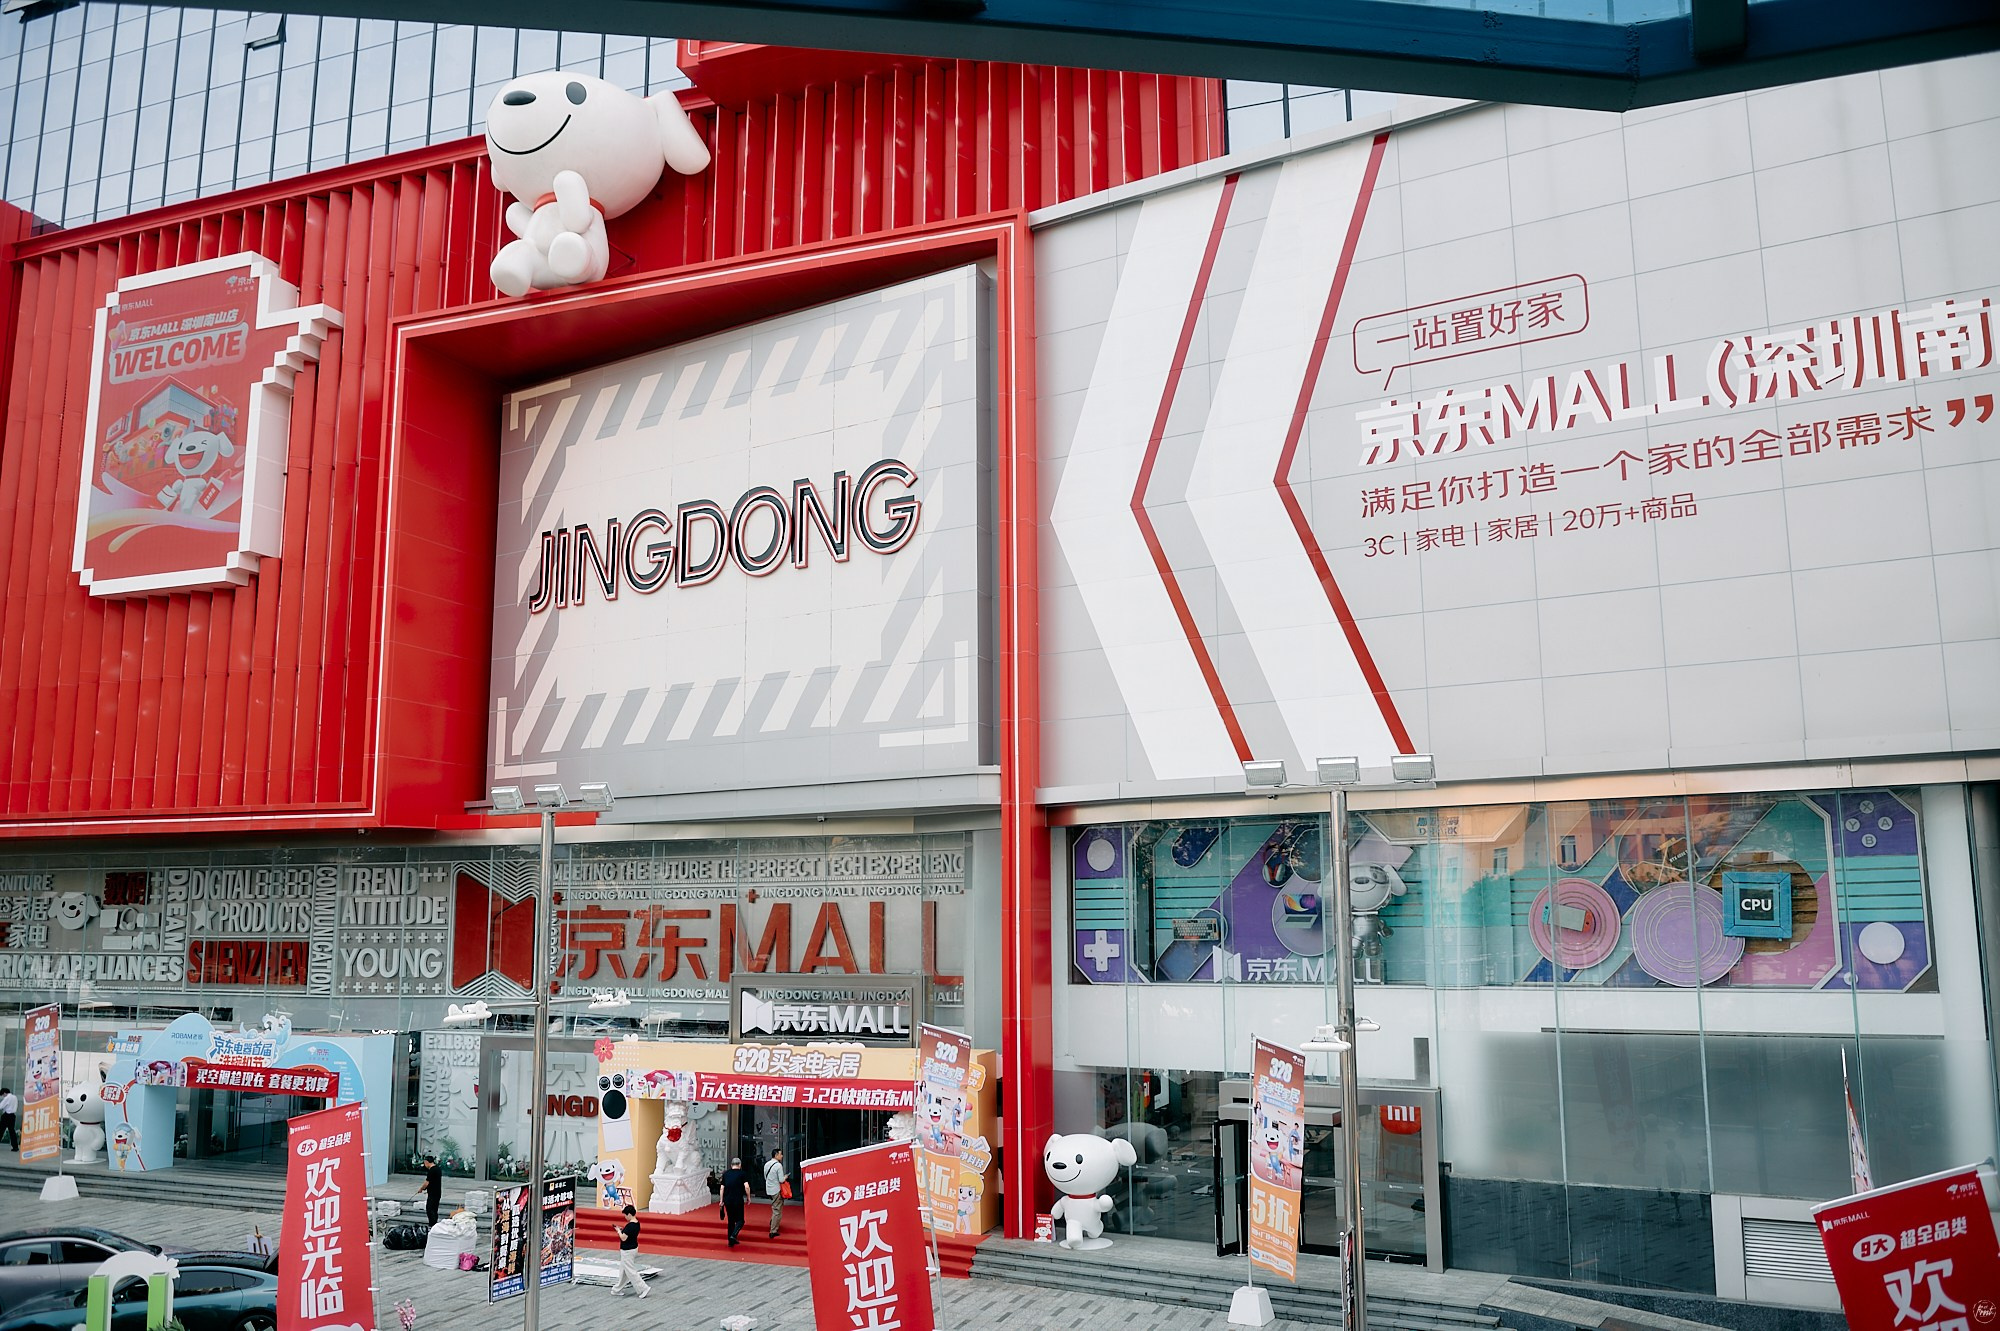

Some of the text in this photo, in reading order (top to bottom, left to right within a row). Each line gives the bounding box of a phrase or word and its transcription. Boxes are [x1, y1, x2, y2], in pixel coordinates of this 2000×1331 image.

[129, 309, 240, 341] 京东MALL 深圳南山店
[1376, 292, 1565, 352] 一站置好家
[114, 330, 243, 377] WELCOME
[1355, 298, 2000, 467] 京东MALL(深圳南
[529, 458, 921, 614] JINGDONG
[1364, 492, 1698, 558] 3C 家电 家居 20万+商品
[552, 862, 617, 881] MEETING
[619, 861, 649, 880] THE
[651, 860, 712, 880] FUTURE
[713, 858, 748, 879] THE
[749, 857, 821, 878] PERFECT
[191, 869, 255, 900] DIGITAL
[562, 890, 618, 900] JINGDONG
[759, 886, 822, 898] JINGDONG
[859, 885, 922, 897] JINGDONG
[11, 896, 49, 921] 家居
[164, 870, 189, 951] DREAM
[218, 902, 312, 933] PRODUCTS
[341, 896, 448, 925] ATTITUDE
[1740, 899, 1772, 911] CPU
[9, 923, 48, 949] 家电
[309, 866, 337, 995] COMMUNICATION
[556, 900, 964, 986] 京东MALL
[55, 955, 184, 982] APPLIANCES
[186, 940, 310, 986] SHENZHEN
[340, 947, 444, 978] YOUNG
[1247, 958, 1381, 983] 京东MLL
[758, 989, 821, 1000] JINGDONG
[773, 1005, 909, 1034] 京东MALL
[213, 1036, 273, 1056] 京东电器首届
[935, 1041, 959, 1063] 328
[196, 1068, 264, 1088] 买空调趁现在
[268, 1073, 329, 1093] 套餐更划算
[1270, 1057, 1293, 1083] 328
[421, 1065, 437, 1145] MONDAY
[700, 1081, 914, 1107] 万人空巷抢空调 3.28快来京东M
[827, 1177, 901, 1204] 9大 超全品类
[1959, 1182, 1977, 1193] 京东
[1832, 1211, 1870, 1228] 京东MALL
[300, 1157, 344, 1320] 欢迎光临
[1861, 1215, 1968, 1258] 9大 超全品类
[1883, 1258, 1971, 1331] 欢
